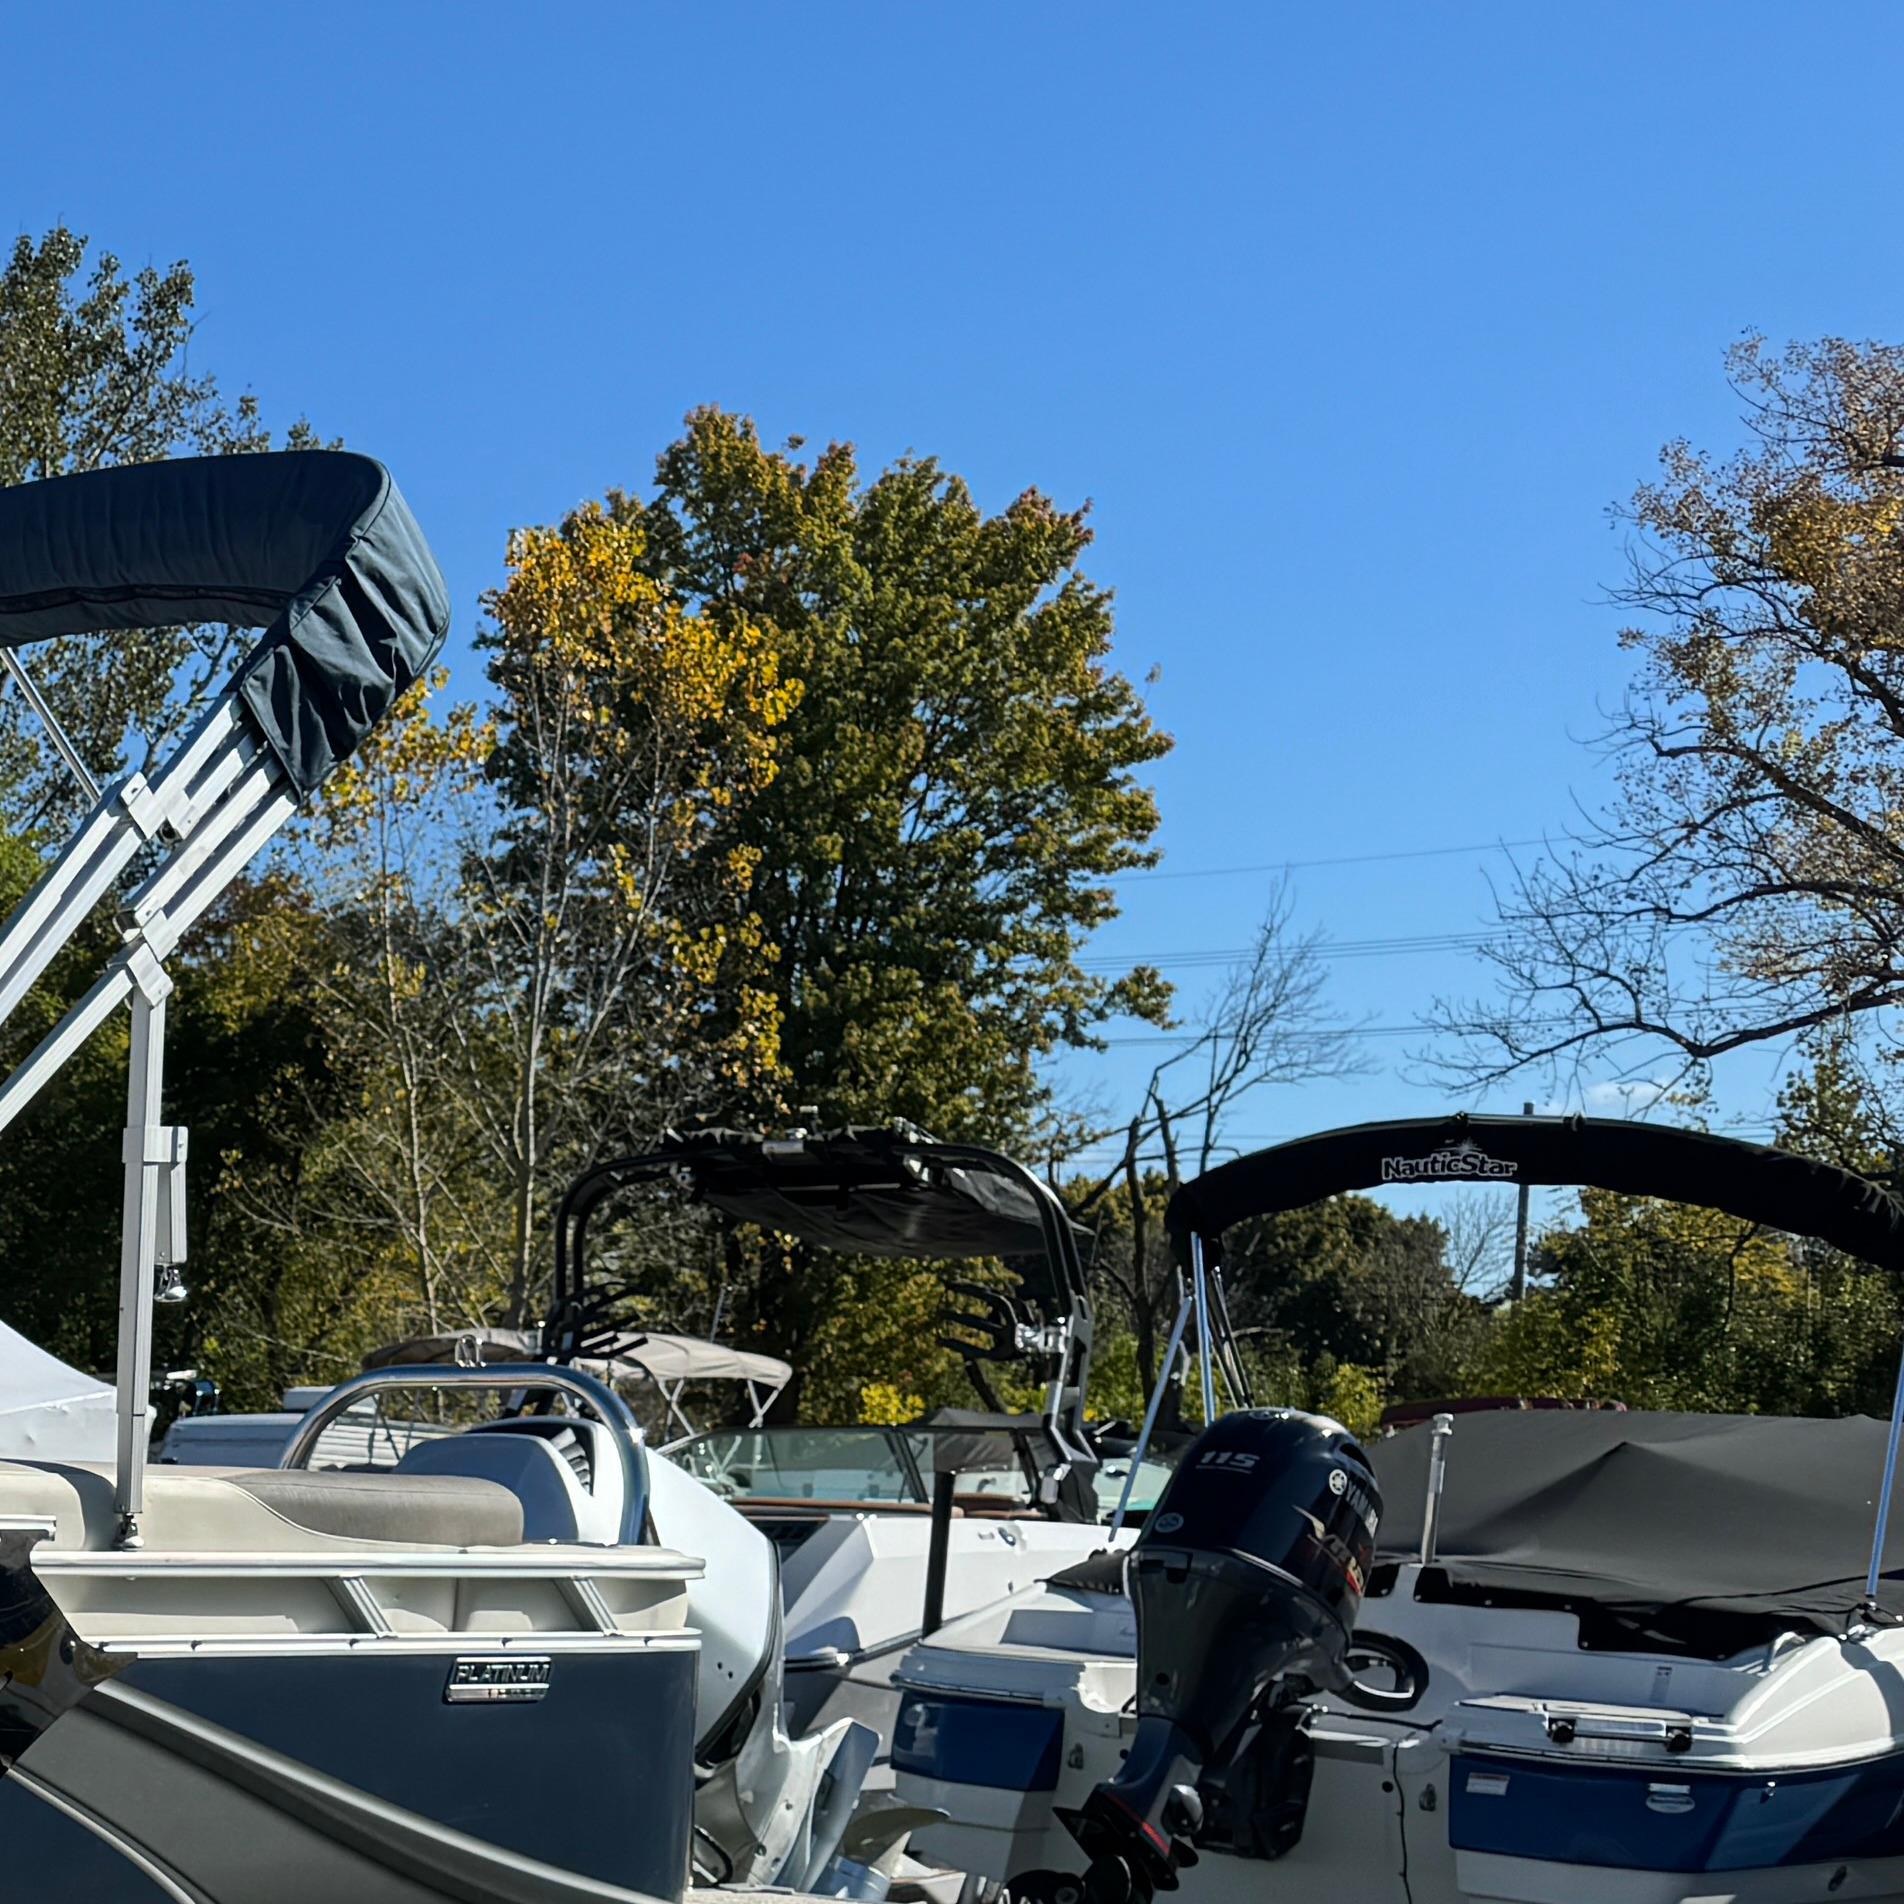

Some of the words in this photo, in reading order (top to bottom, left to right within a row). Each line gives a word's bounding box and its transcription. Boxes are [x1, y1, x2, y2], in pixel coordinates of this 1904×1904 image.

[1381, 1151, 1517, 1181] NauticStar
[1200, 1451, 1260, 1468] 115
[456, 1664, 549, 1682] PLATINUM
